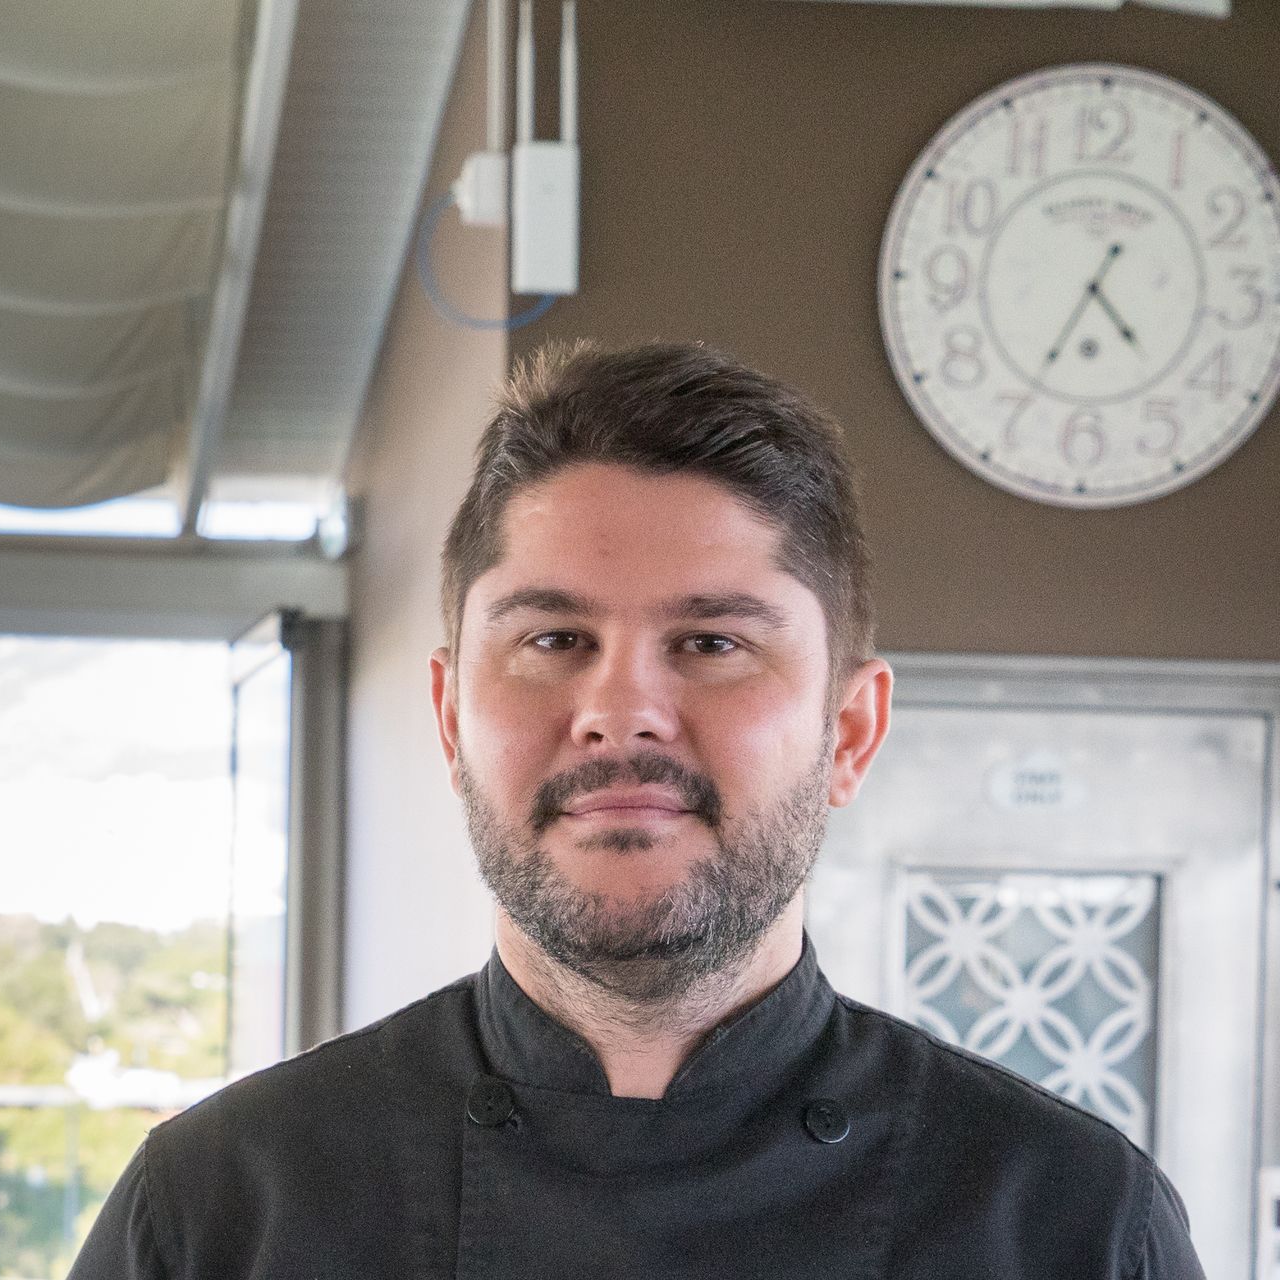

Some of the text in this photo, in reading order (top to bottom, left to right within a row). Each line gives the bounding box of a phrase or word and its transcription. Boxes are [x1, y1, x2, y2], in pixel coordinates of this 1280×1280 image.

[1004, 110, 1049, 178] 11
[1072, 103, 1136, 162] 12
[1169, 128, 1187, 191] 1
[942, 175, 999, 237] 10
[1204, 186, 1247, 250] 2
[924, 244, 970, 314] 9
[1216, 263, 1264, 331] 3
[939, 323, 986, 391] 8
[1182, 342, 1236, 402] 4
[994, 390, 1036, 450] 7
[1060, 402, 1105, 469] 6
[1136, 397, 1184, 460] 5
